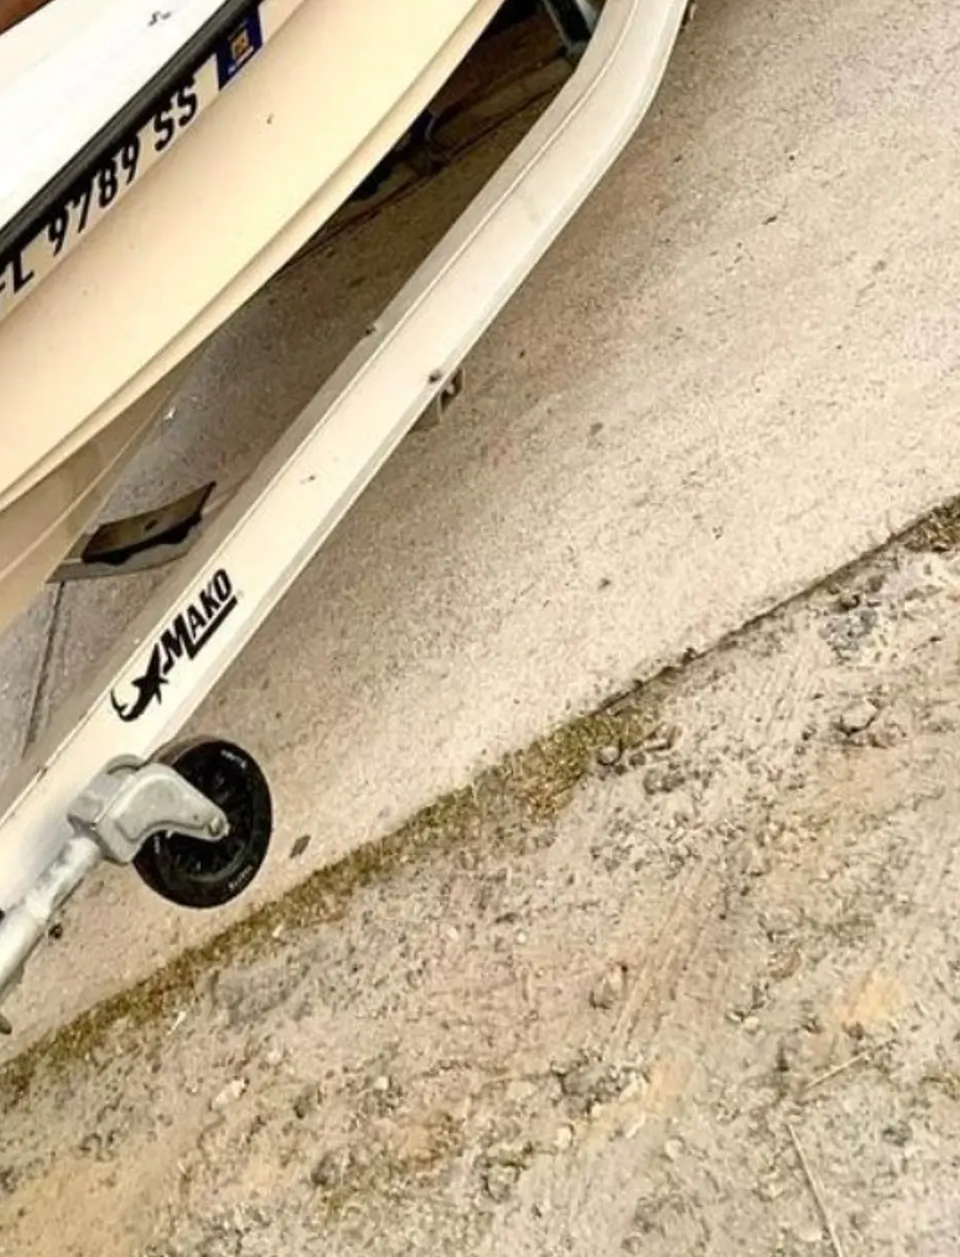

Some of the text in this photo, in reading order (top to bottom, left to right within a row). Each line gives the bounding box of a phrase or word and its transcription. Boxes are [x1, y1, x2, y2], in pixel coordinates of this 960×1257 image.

[48, 135, 140, 257] 9789
[154, 80, 198, 152] SS
[161, 568, 238, 675] MAKO
